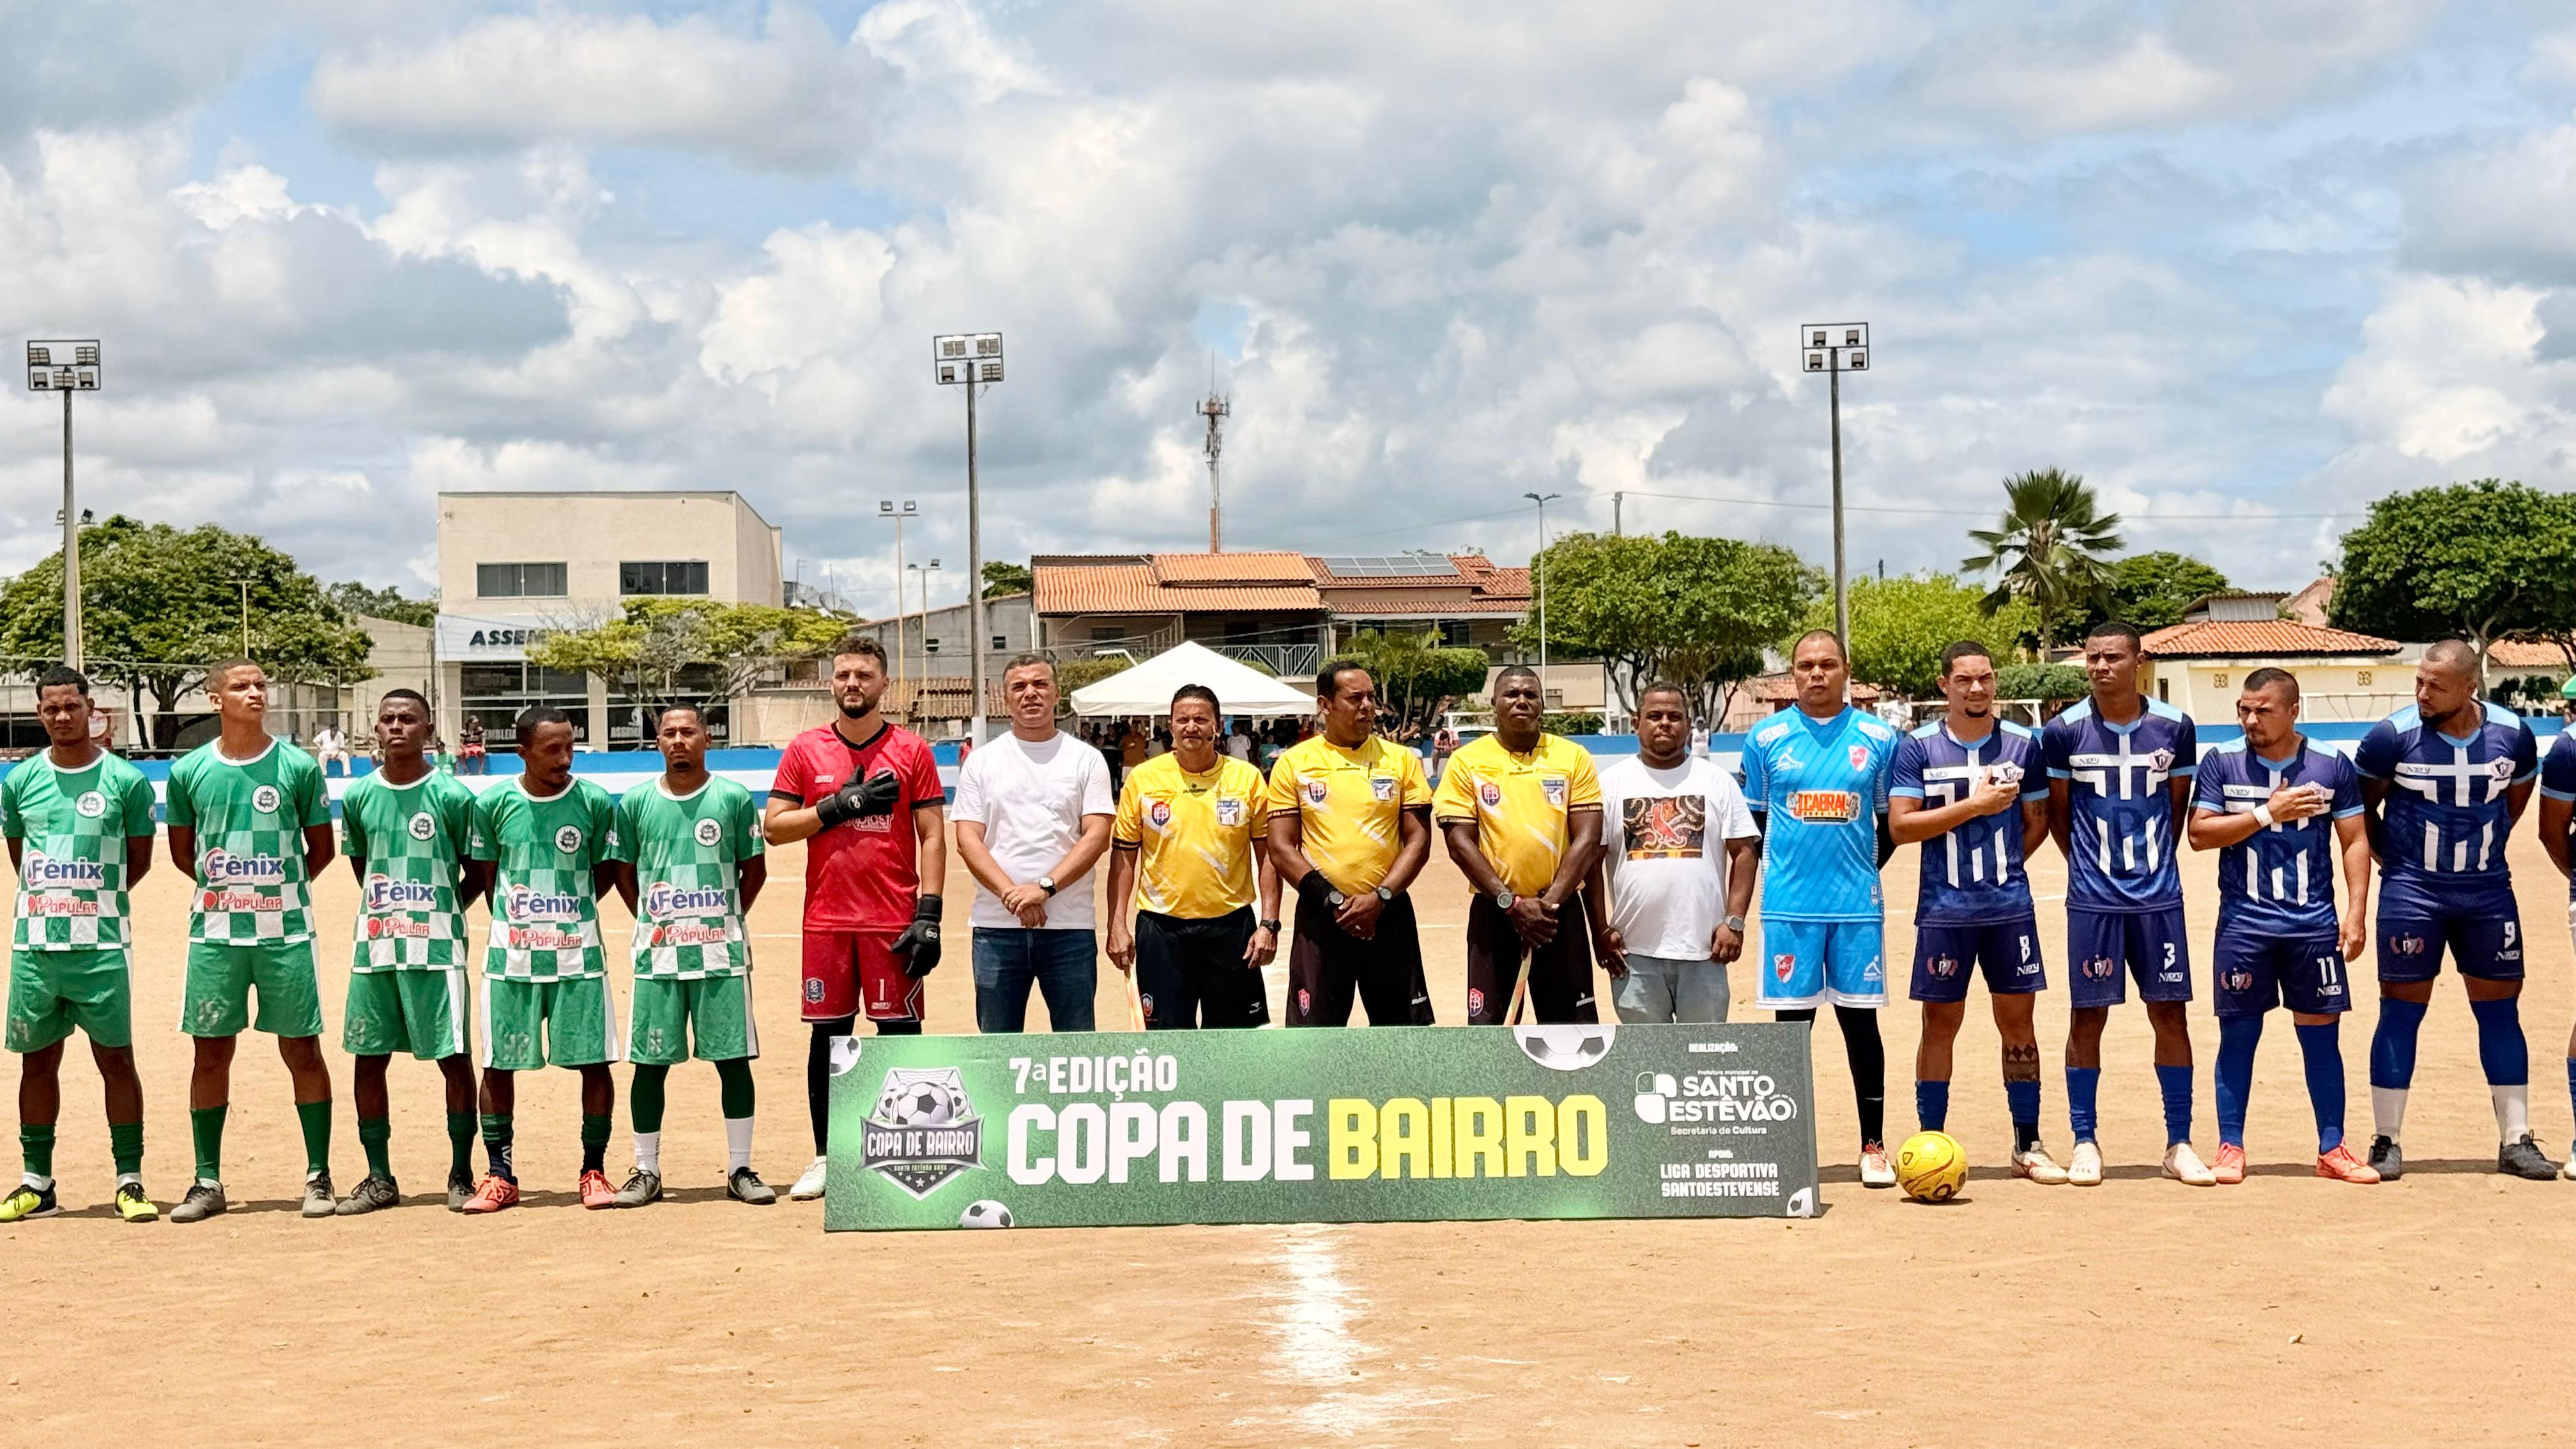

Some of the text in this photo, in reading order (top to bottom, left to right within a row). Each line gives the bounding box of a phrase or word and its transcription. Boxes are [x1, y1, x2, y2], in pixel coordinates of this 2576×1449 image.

[32, 859, 103, 880] Fênix
[211, 855, 283, 876] Fênix
[516, 893, 579, 913] Fênix
[658, 887, 726, 910] Fênix
[2504, 921, 2515, 949] 9
[2019, 935, 2030, 964] 8
[2163, 942, 2175, 970] 3
[2317, 956, 2337, 986] 11
[879, 979, 884, 1001] 1
[1688, 1042, 1738, 1054] REALIZAÇÃO:
[1683, 1075, 1775, 1098] SANTO
[1669, 1094, 1791, 1122] ESTÊVÃO
[1007, 1095, 1608, 1185] COPA DE BAIRRO
[1671, 1126, 1717, 1135] Secretaria
[1732, 1126, 1767, 1135] Cultura
[867, 1130, 974, 1157] COPA DE BAIRRO
[1708, 1150, 1733, 1159] APOIO:
[1660, 1163, 1778, 1179] LIGA DESPORTIVA
[1661, 1181, 1780, 1197] SANTOESTEVENSE
